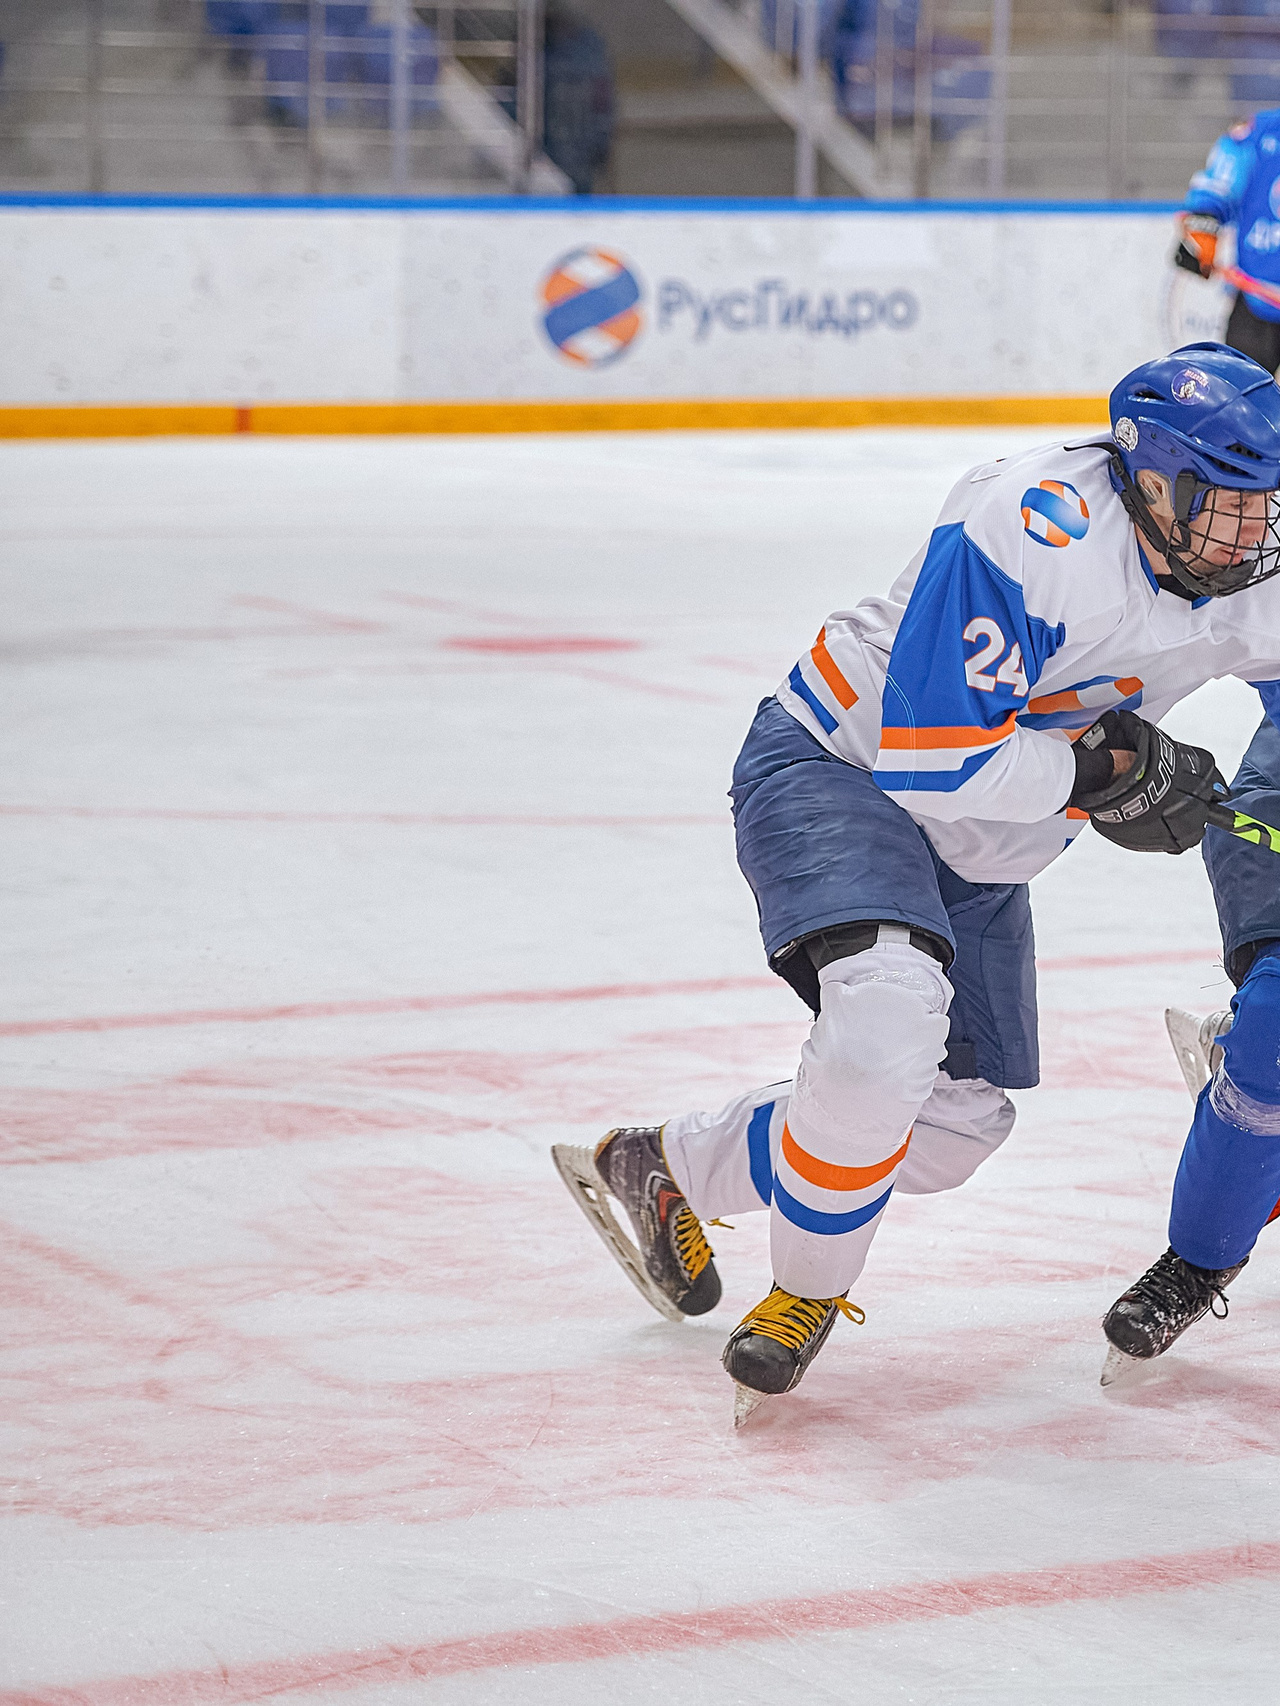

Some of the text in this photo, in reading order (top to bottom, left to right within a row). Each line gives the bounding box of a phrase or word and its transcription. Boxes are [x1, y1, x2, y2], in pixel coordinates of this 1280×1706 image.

[657, 277, 918, 342] РусГидро
[963, 616, 1029, 697] 24
[1094, 725, 1176, 823] BAUE
